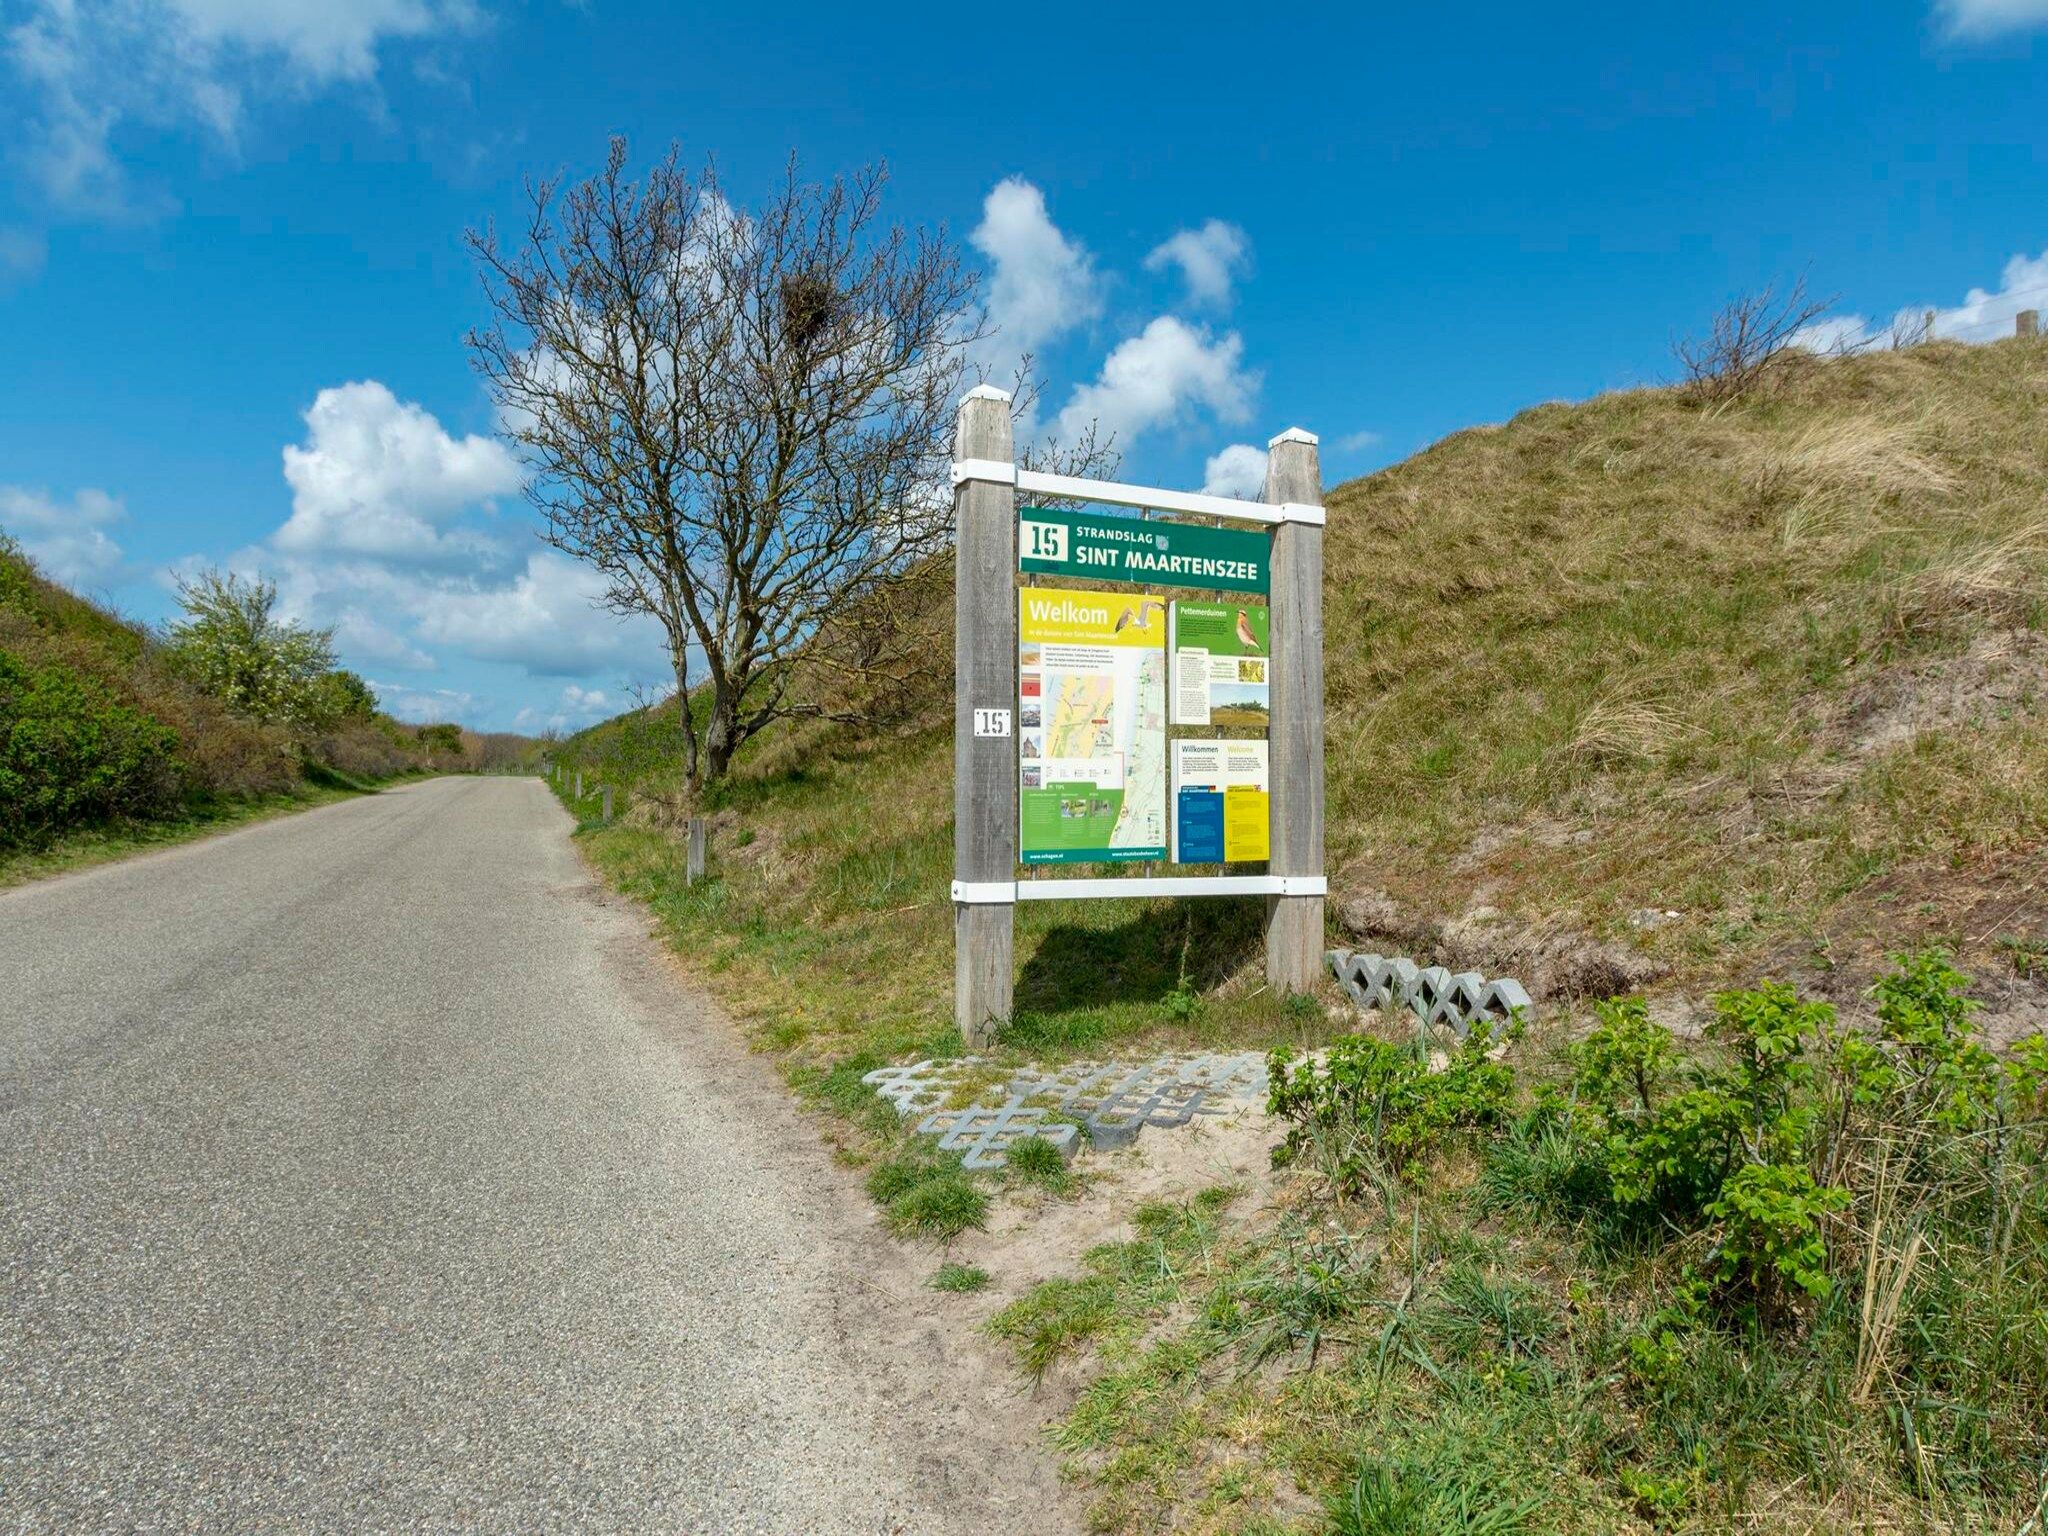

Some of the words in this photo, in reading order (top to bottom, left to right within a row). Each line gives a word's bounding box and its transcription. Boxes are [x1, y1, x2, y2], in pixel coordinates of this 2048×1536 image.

[1031, 525, 1059, 557] 15
[1076, 526, 1153, 544] STRANDSLAG
[1076, 546, 1119, 567] SINT
[1125, 552, 1258, 580] MAARTENSZEE
[1029, 600, 1108, 625] Welkom
[983, 712, 1003, 734] 15
[1181, 745, 1219, 754] Willkommen
